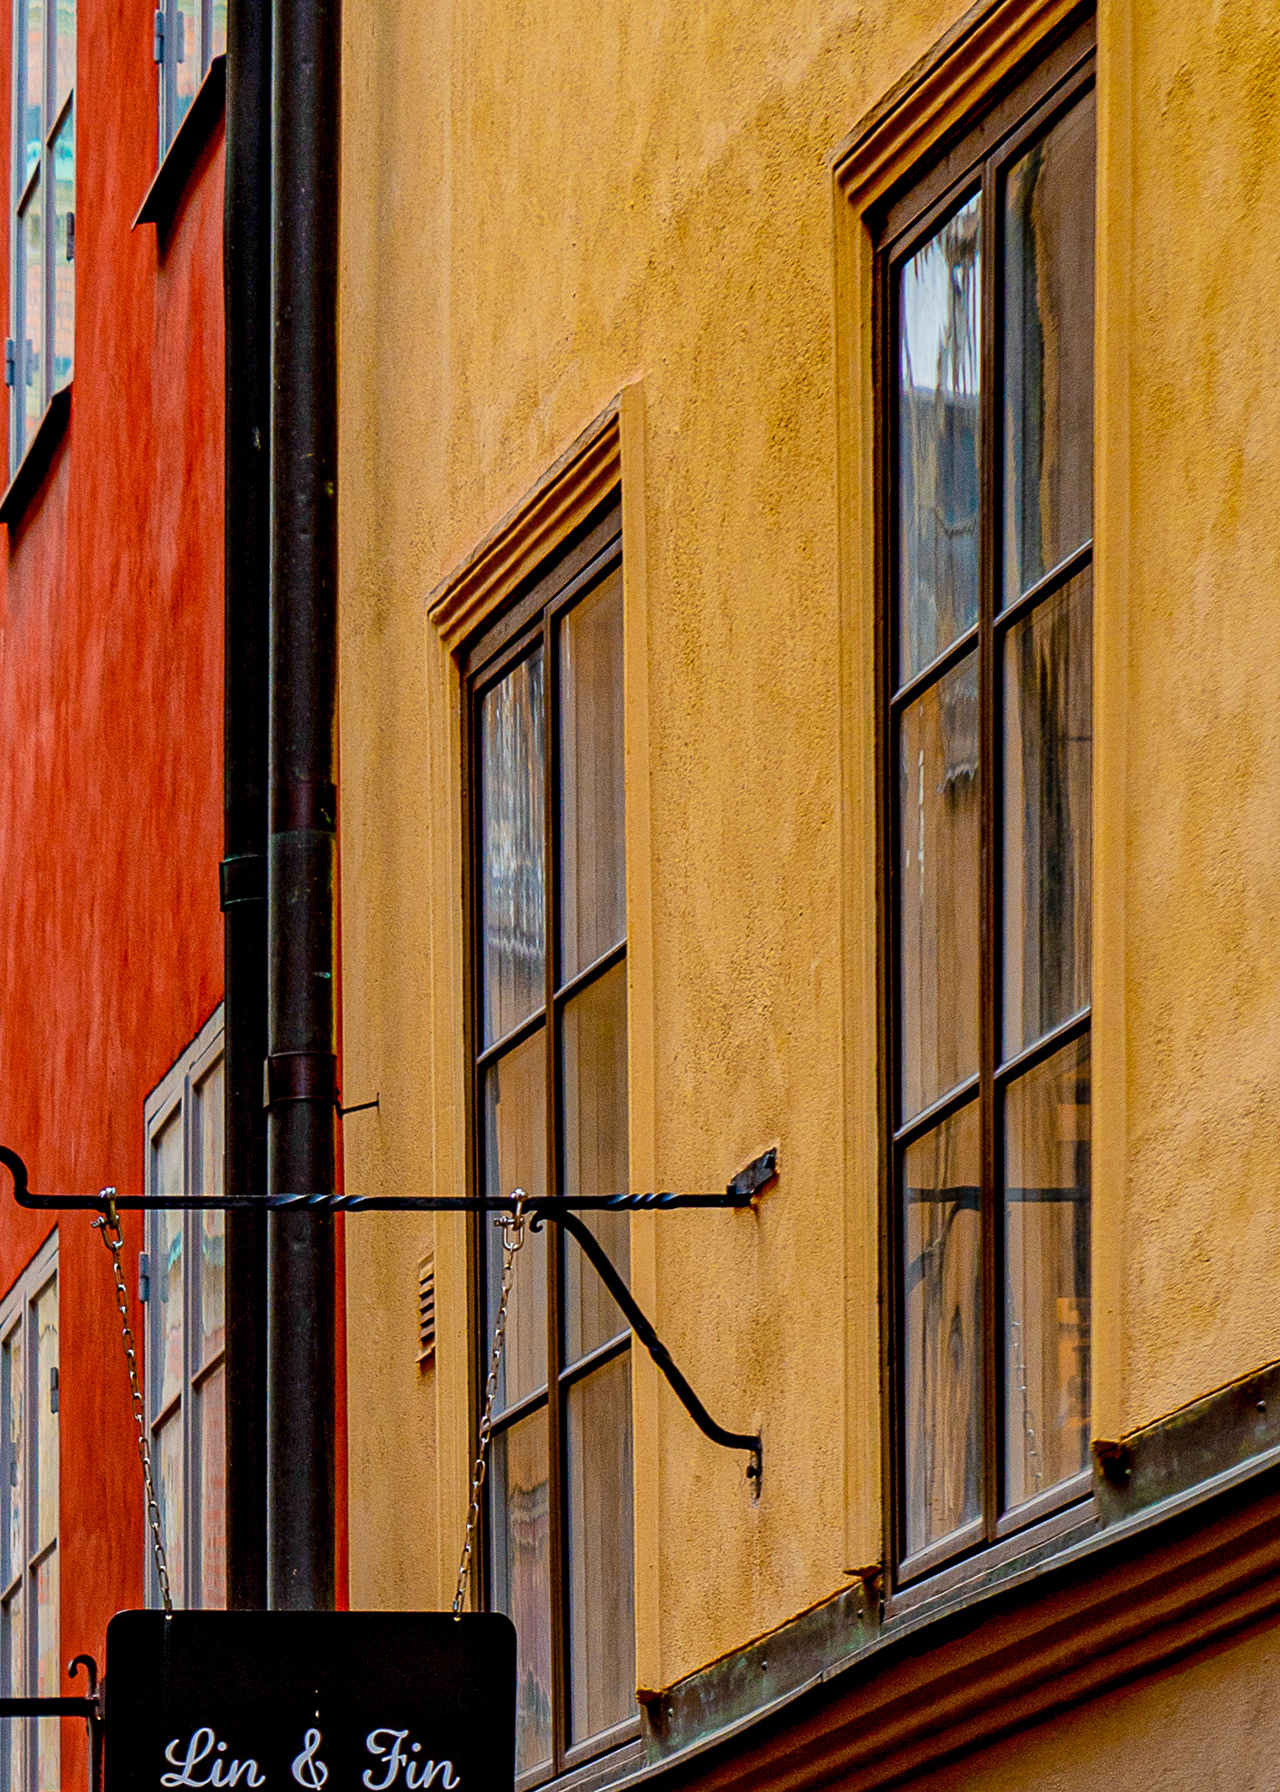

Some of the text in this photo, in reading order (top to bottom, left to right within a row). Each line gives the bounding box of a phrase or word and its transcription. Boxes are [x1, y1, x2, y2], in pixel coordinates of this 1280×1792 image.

[160, 1727, 461, 1791] Lin & Fin
